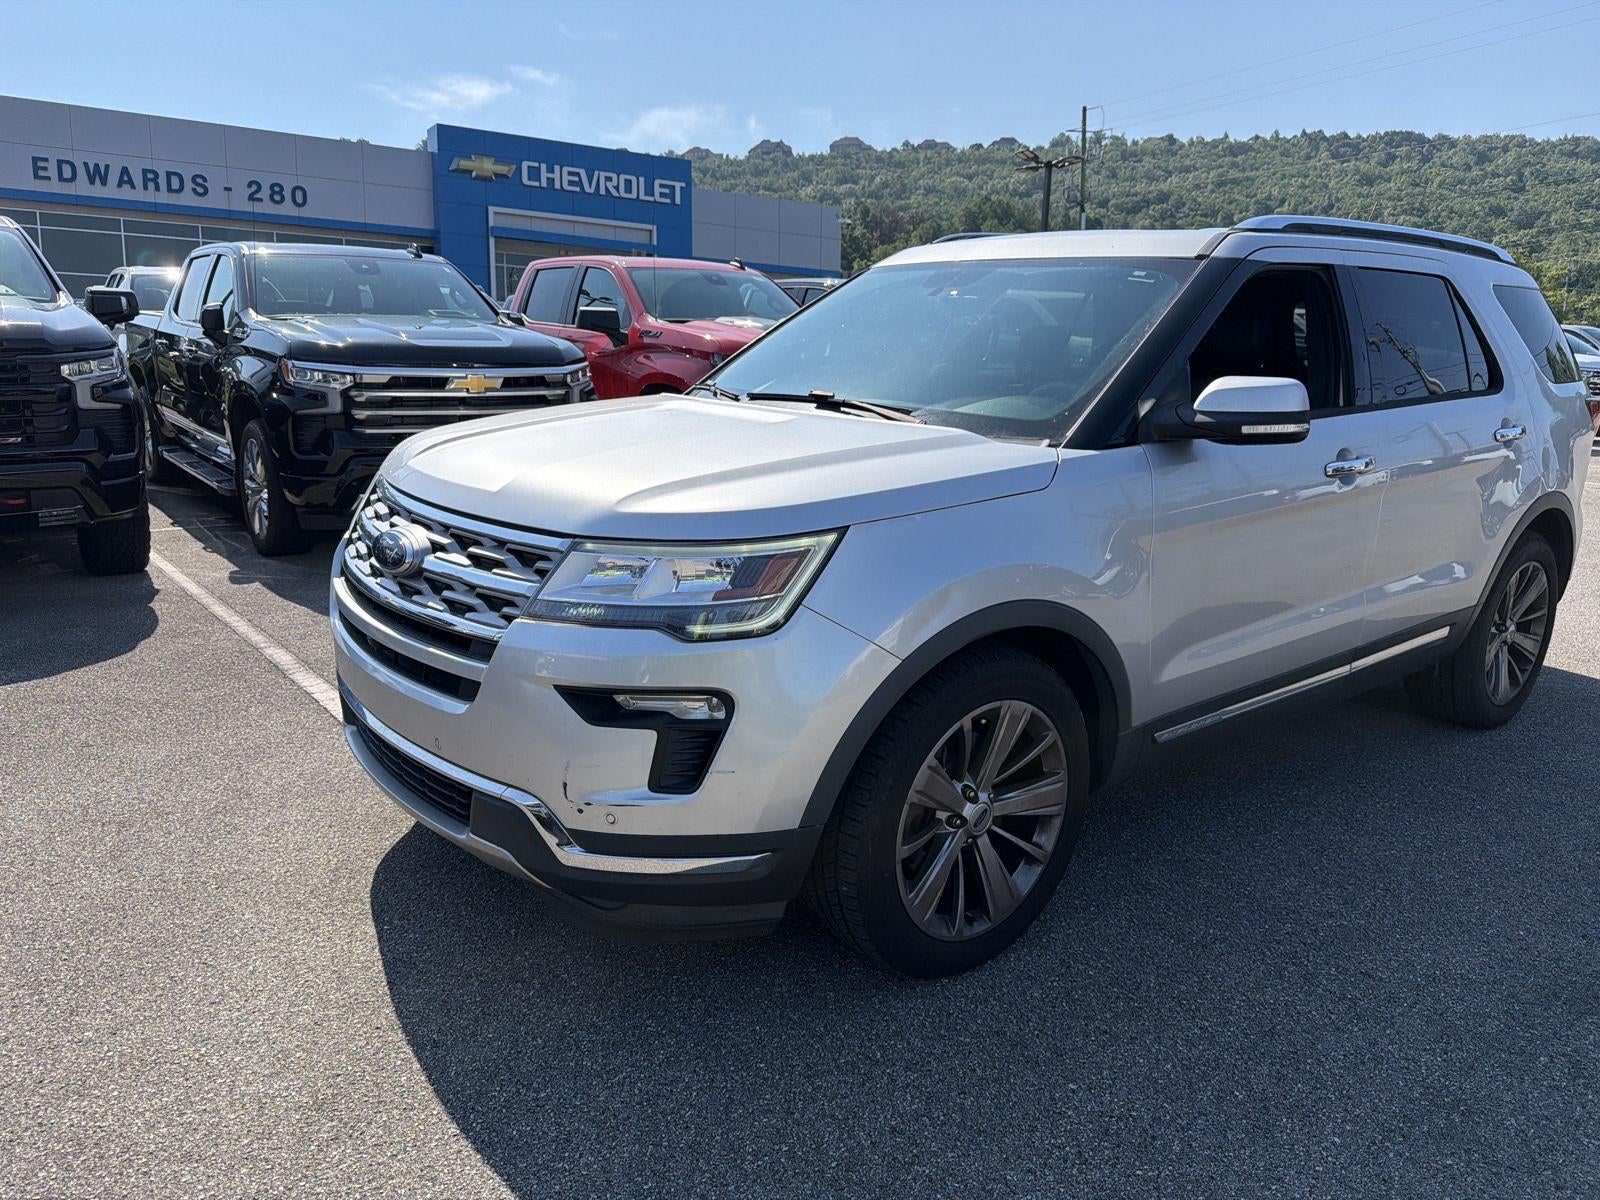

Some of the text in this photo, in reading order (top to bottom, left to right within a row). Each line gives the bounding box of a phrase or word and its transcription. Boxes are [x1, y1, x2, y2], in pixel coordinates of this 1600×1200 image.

[31, 156, 209, 198] EDWARDS
[246, 180, 308, 208] 280
[521, 160, 686, 205] CHEVROLET
